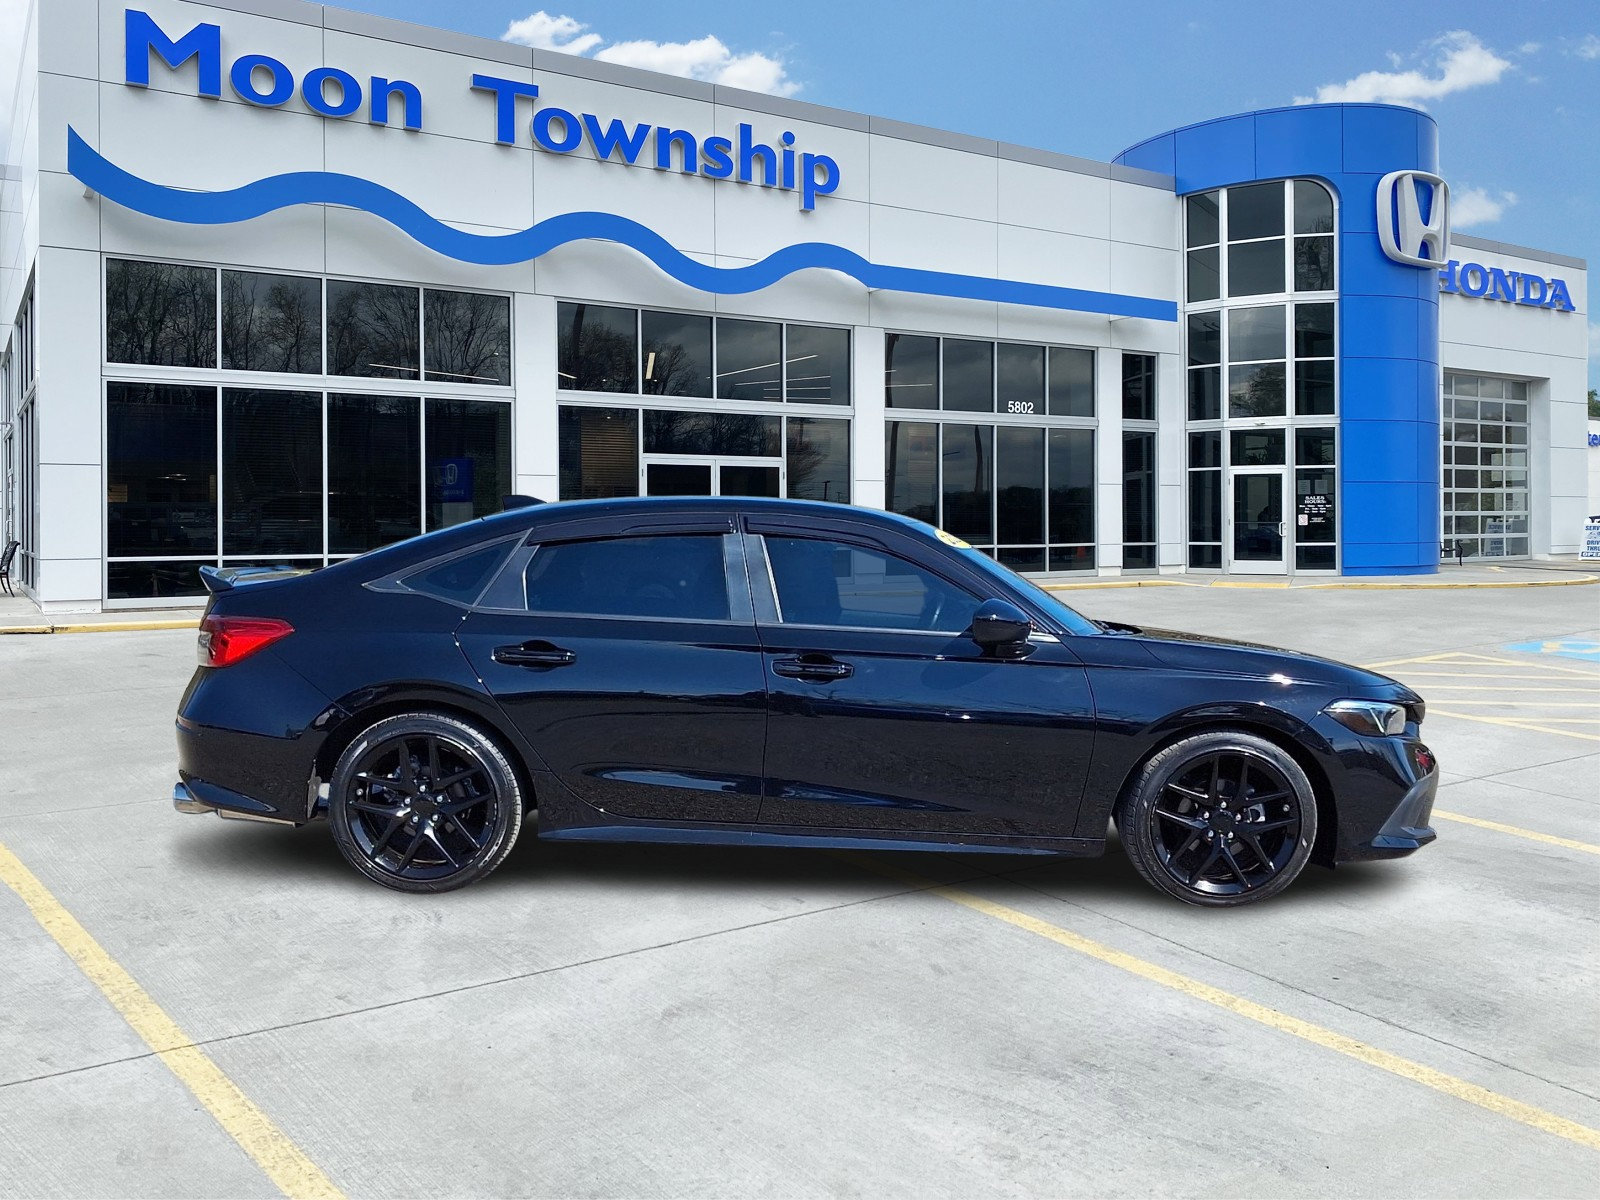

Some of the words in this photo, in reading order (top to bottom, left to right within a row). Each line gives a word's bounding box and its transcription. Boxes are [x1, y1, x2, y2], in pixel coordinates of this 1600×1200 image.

[125, 8, 422, 131] Moon
[470, 73, 841, 212] Township
[1439, 259, 1576, 312] HONDA
[1007, 400, 1034, 414] 5802
